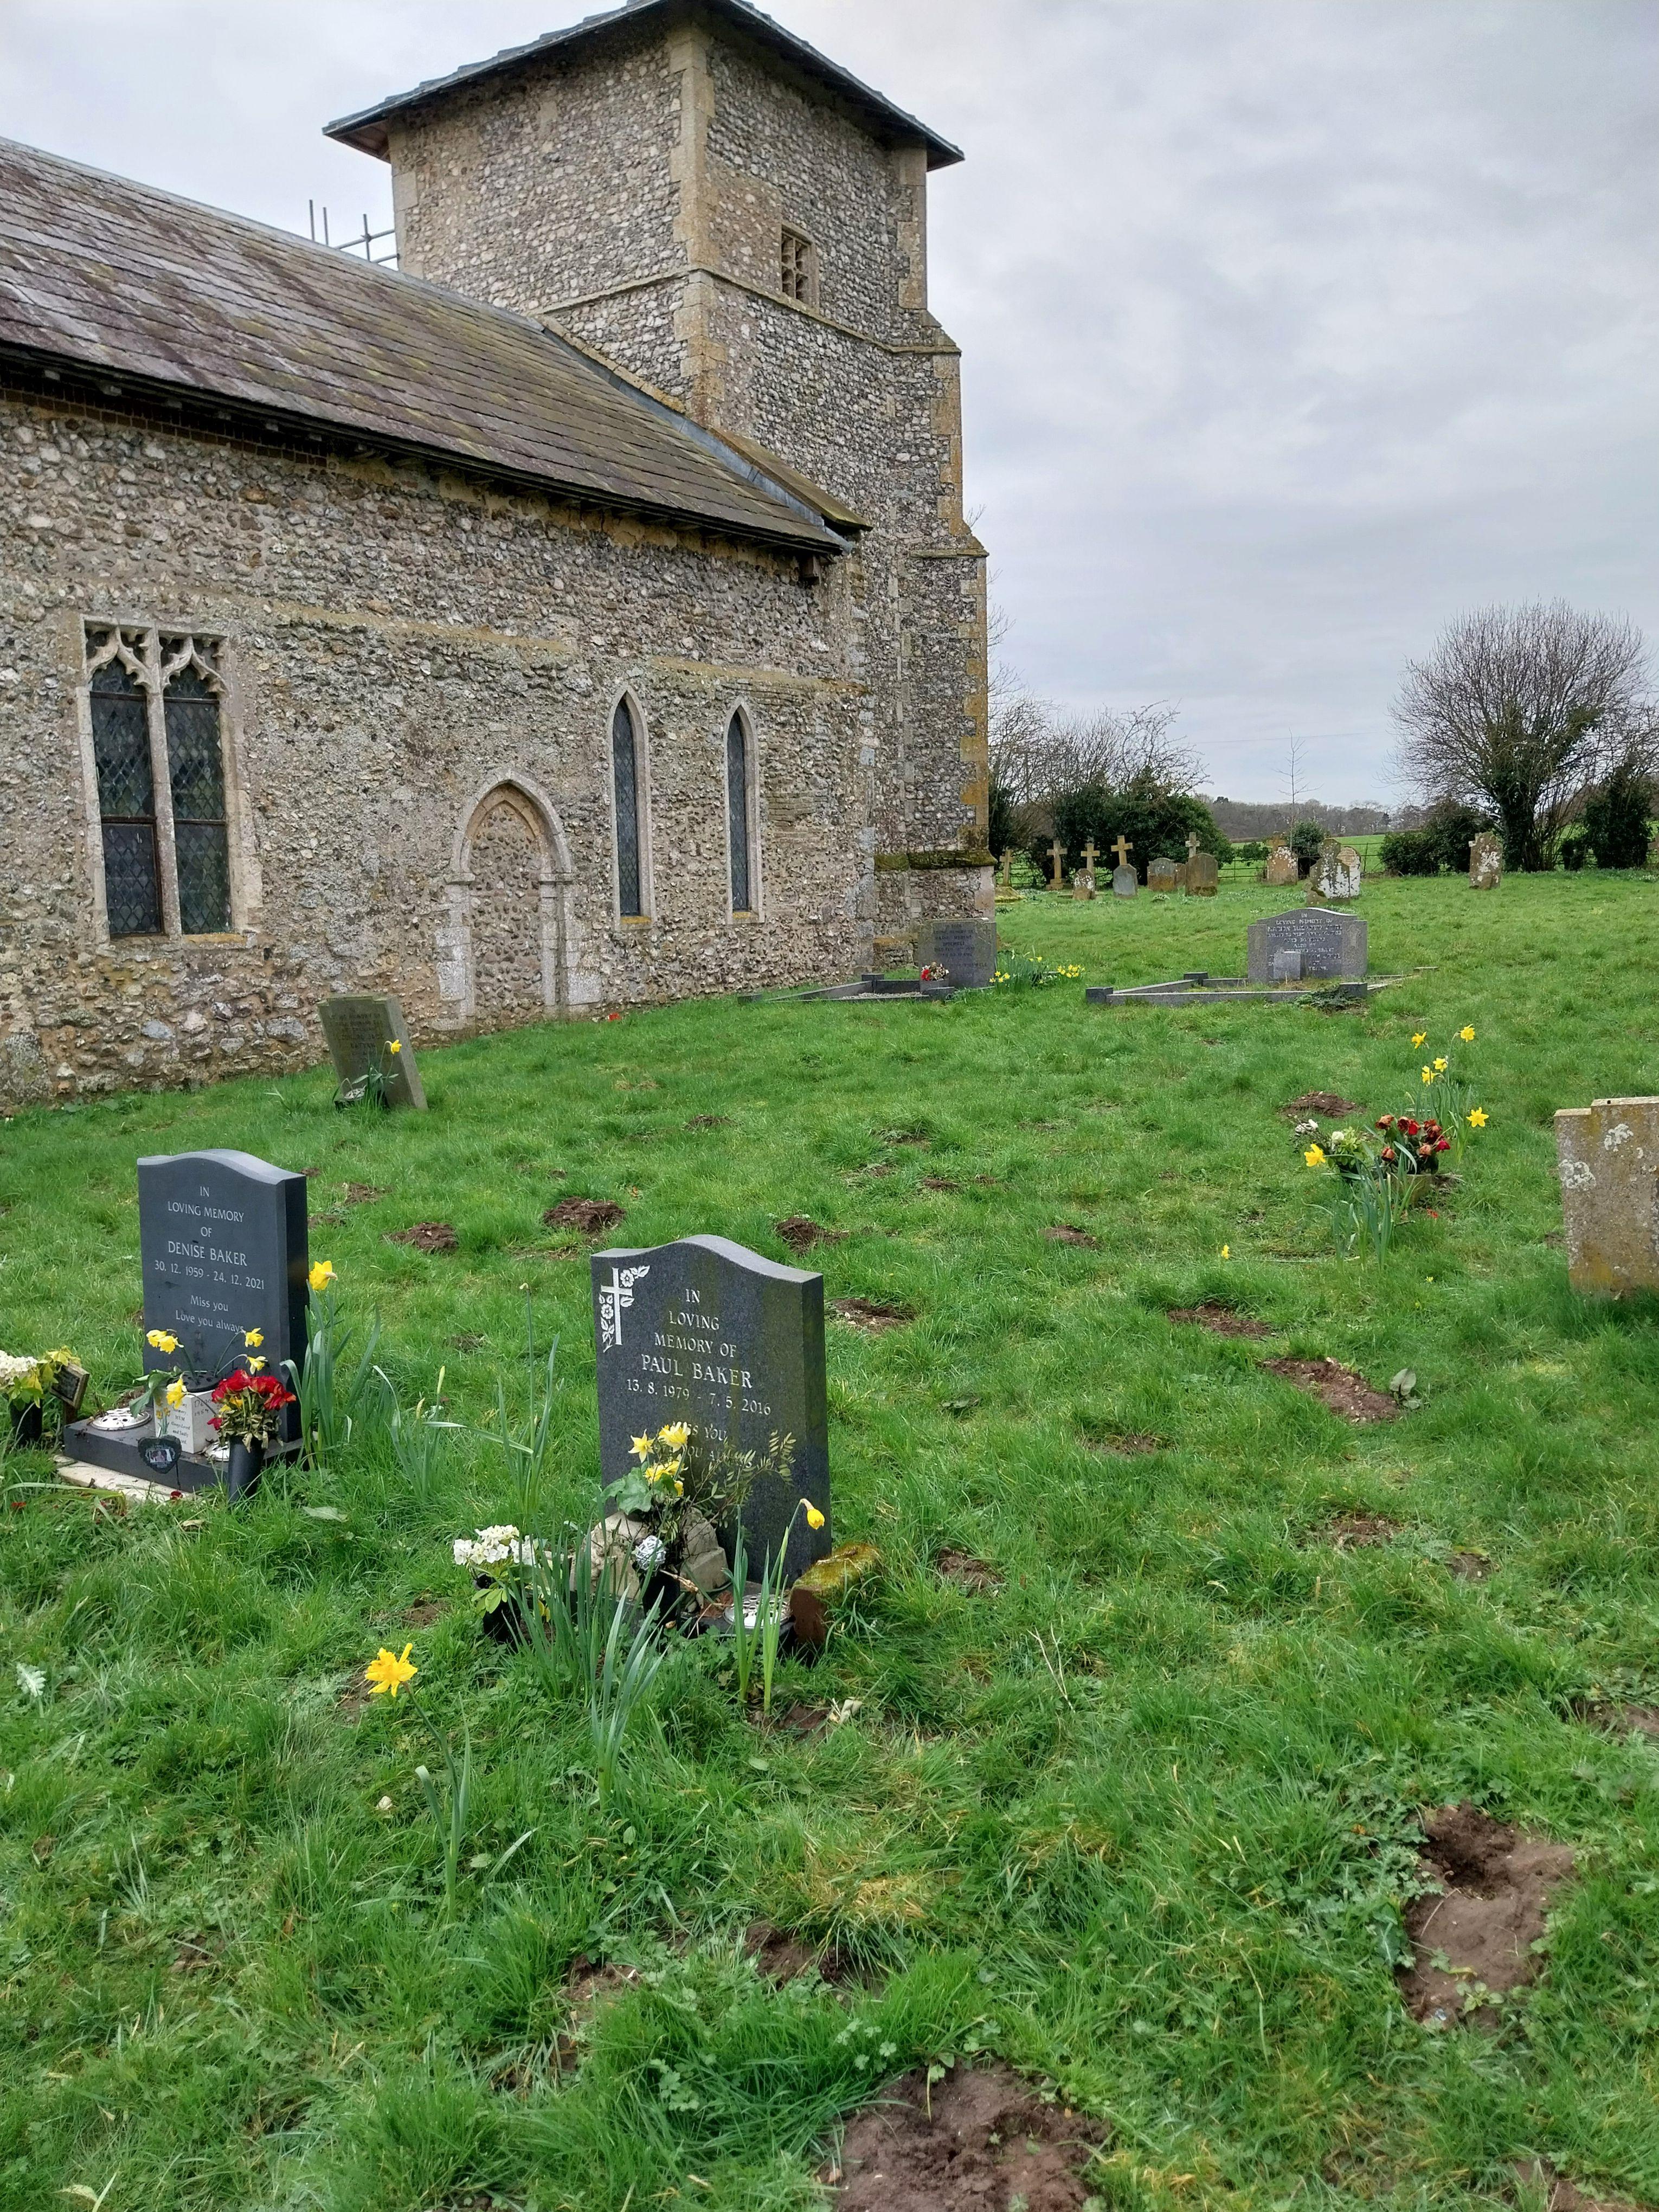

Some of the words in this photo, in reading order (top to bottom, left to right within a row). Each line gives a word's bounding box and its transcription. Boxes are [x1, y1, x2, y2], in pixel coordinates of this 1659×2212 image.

[200, 1186, 209, 1197] IN
[168, 1201, 201, 1216] LOVING
[204, 1207, 244, 1222] MEMORY
[201, 1226, 212, 1237] OF
[168, 1241, 205, 1259] DENISE
[210, 1248, 247, 1266] BAKER
[155, 1260, 166, 1271] 30.
[171, 1263, 182, 1274] 12.
[185, 1266, 204, 1278] 1959
[213, 1271, 227, 1283] 24.
[231, 1275, 242, 1285] 12.
[246, 1277, 265, 1290] 2021
[190, 1295, 210, 1308] Miss
[213, 1302, 228, 1311] you
[685, 1289, 700, 1303] IN
[176, 1310, 195, 1323] Love
[198, 1317, 213, 1327] you
[216, 1320, 244, 1334] always
[669, 1310, 719, 1330] LOVING
[654, 1332, 713, 1354] MEMORY
[719, 1343, 737, 1358] OF
[641, 1354, 683, 1377] PAUL
[692, 1362, 753, 1388] BAKER
[627, 1379, 642, 1392] 13.
[648, 1381, 658, 1395] 8.
[663, 1385, 690, 1400] 1979
[710, 1393, 720, 1407] 7.
[725, 1396, 736, 1409] 5.
[742, 1398, 771, 1415] 2016
[705, 1424, 726, 1441] YOU
